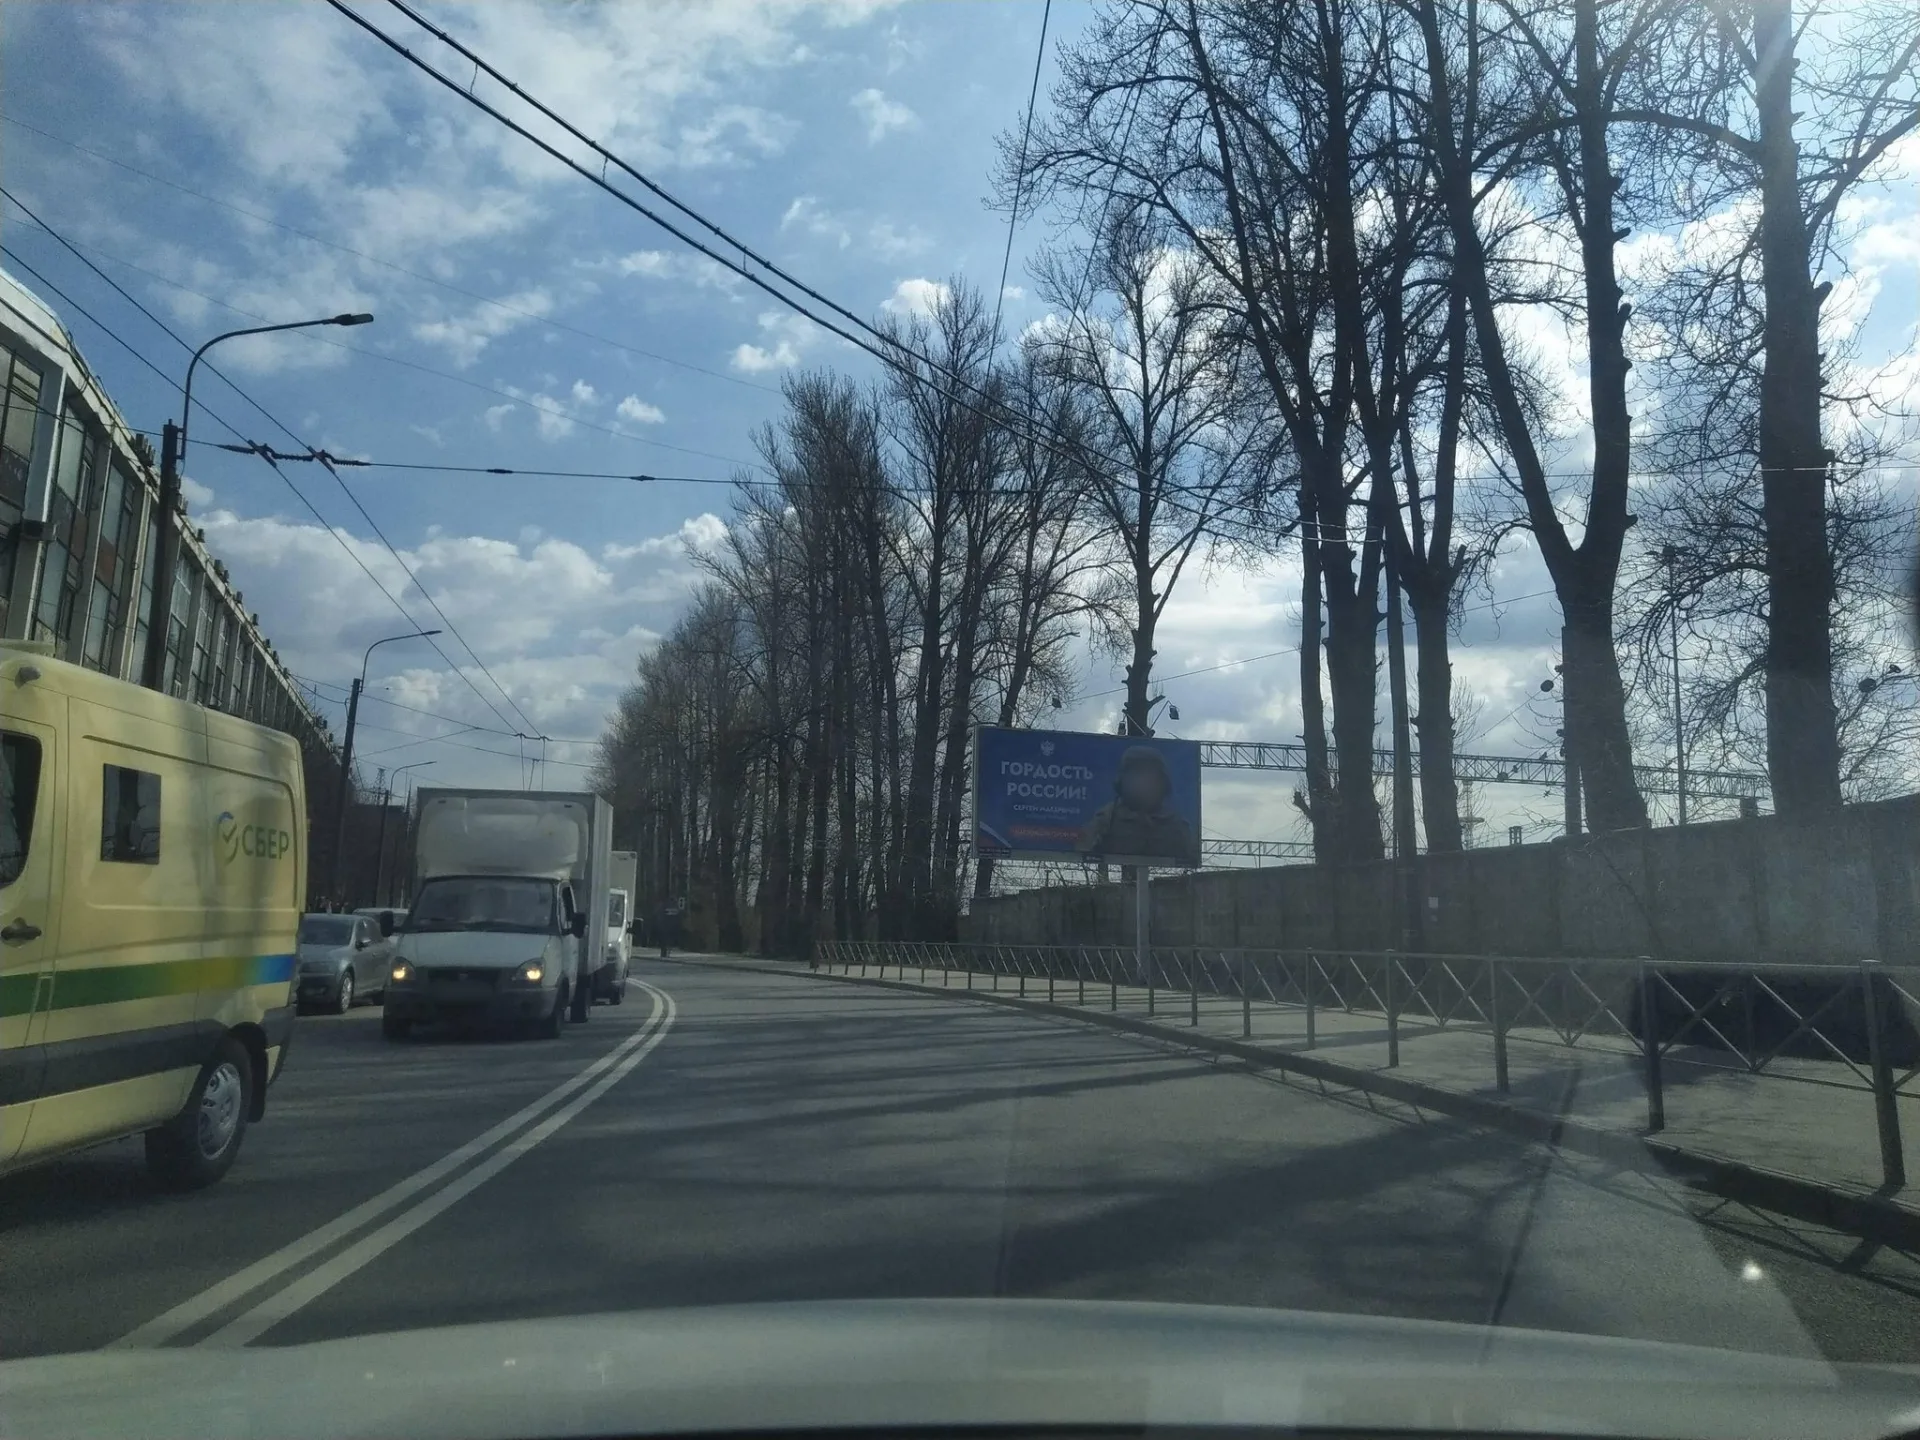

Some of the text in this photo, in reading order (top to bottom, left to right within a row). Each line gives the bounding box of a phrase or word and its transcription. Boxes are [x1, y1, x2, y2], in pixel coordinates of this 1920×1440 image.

[1001, 761, 1093, 780] ГОРДОСТЬ
[1007, 782, 1087, 800] РОССИИ!
[242, 824, 289, 860] СБЕР
